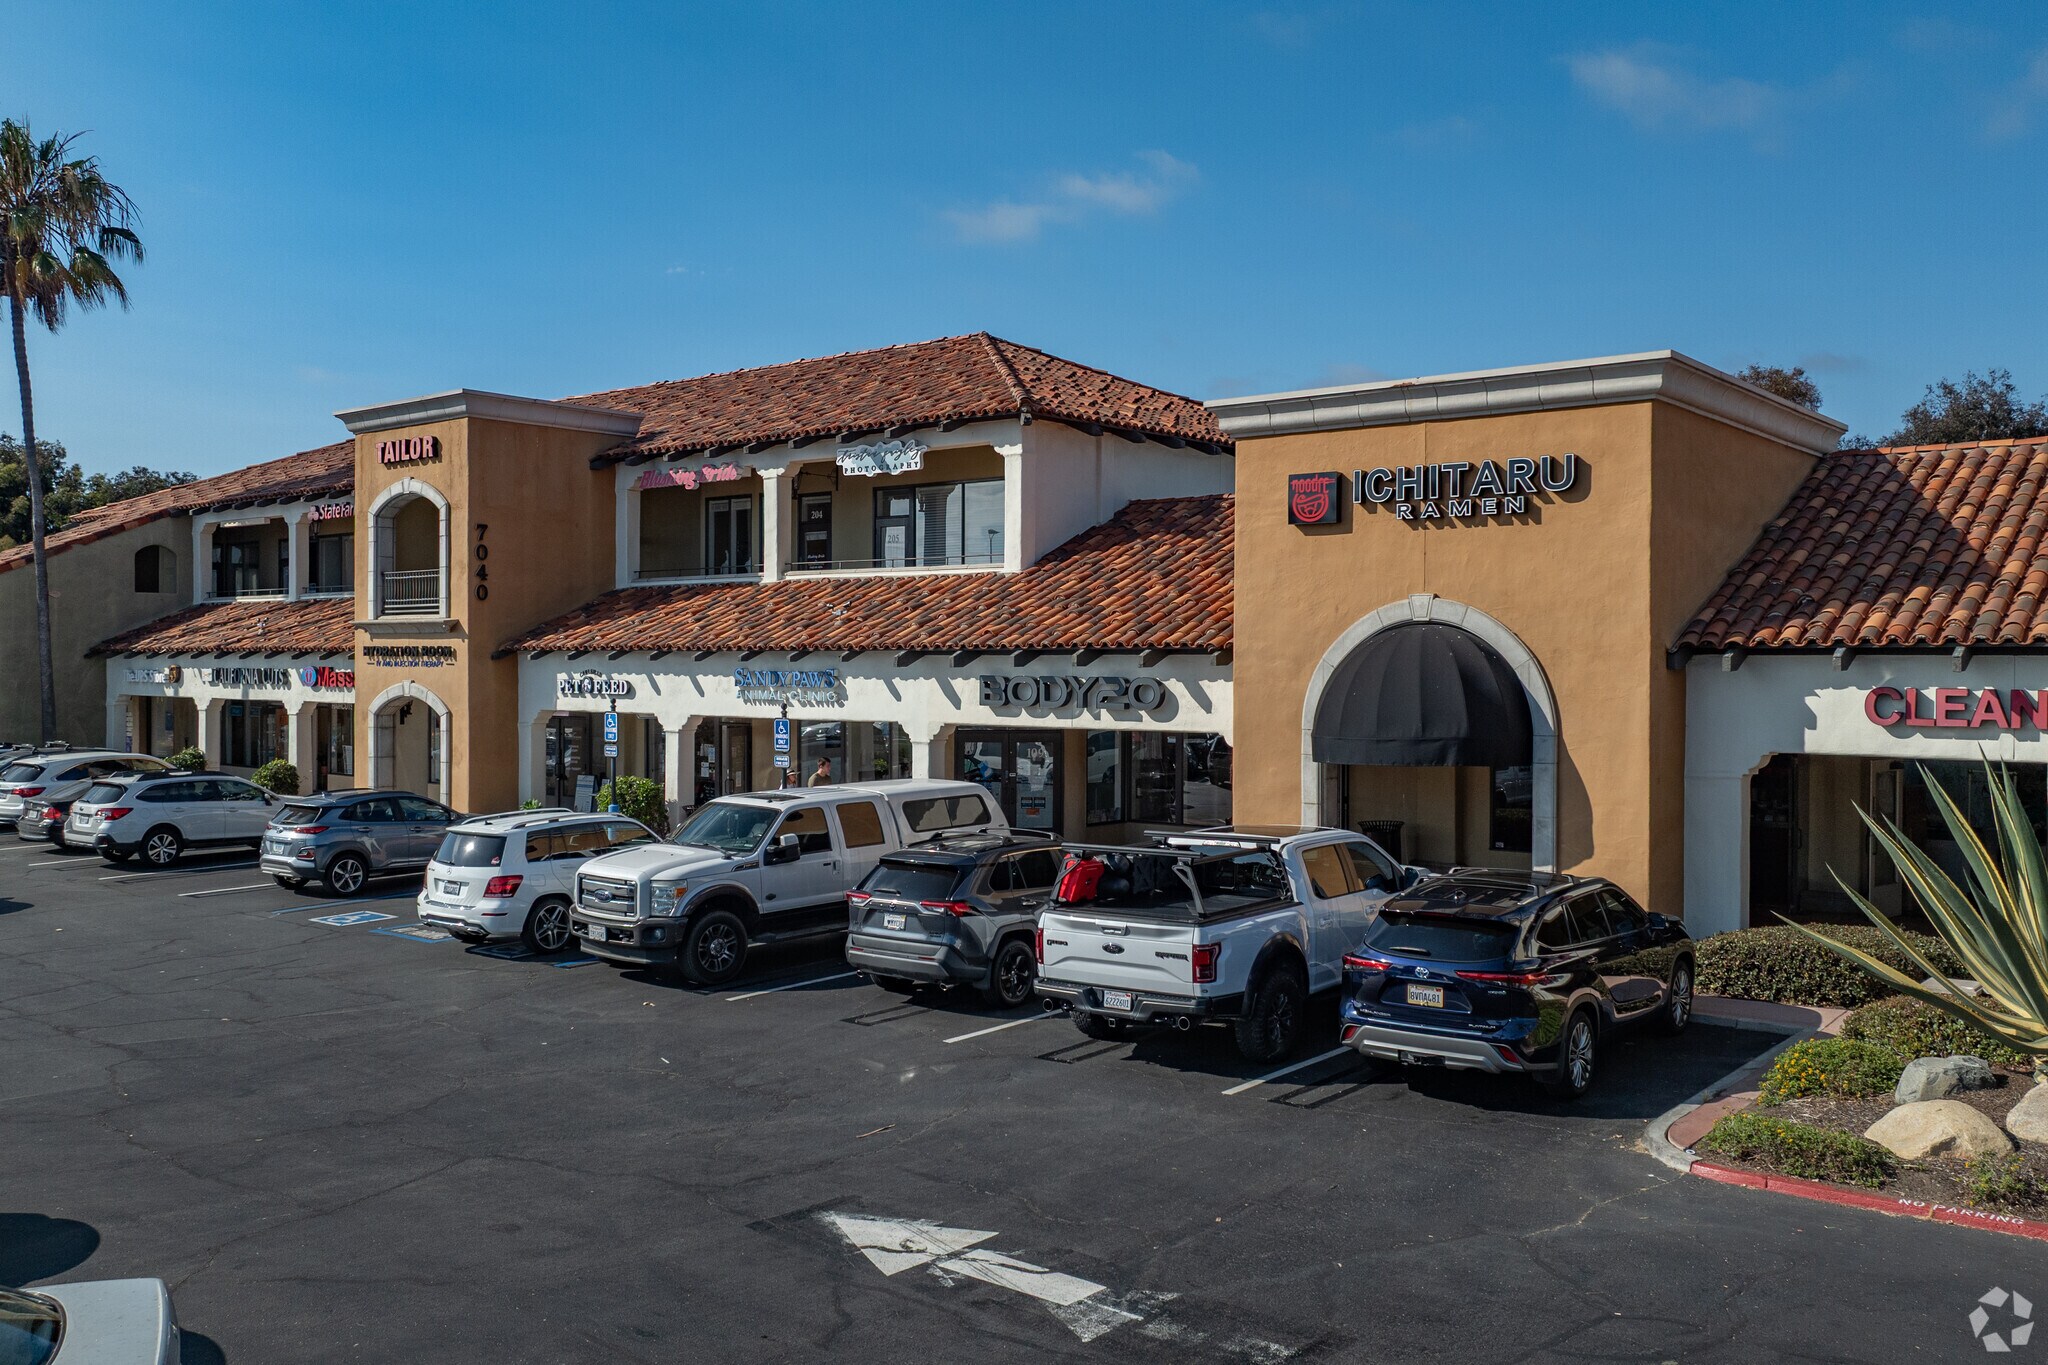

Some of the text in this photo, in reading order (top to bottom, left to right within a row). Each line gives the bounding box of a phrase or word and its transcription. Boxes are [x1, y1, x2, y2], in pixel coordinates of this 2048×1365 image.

[375, 435, 436, 464] TAILOR
[700, 463, 738, 482] Bride
[844, 462, 919, 474] PHOTOGRAPHY
[1353, 453, 1575, 504] ICHITARU
[811, 510, 823, 519] 204
[1396, 496, 1525, 519] RAMEN
[888, 535, 900, 544] 205
[475, 523, 489, 601] 7040
[363, 646, 453, 657] HYDRATION ROOM
[212, 667, 285, 685] CALIFORNIA CUTS
[734, 668, 837, 688] SANDY PAWS
[557, 679, 629, 695] PET FEED
[736, 690, 837, 701] ANIMAL CLINIC
[979, 675, 1166, 711] BODY20
[1864, 687, 2048, 729] CLEAN
[1899, 1198, 2025, 1225] NO PARKING
